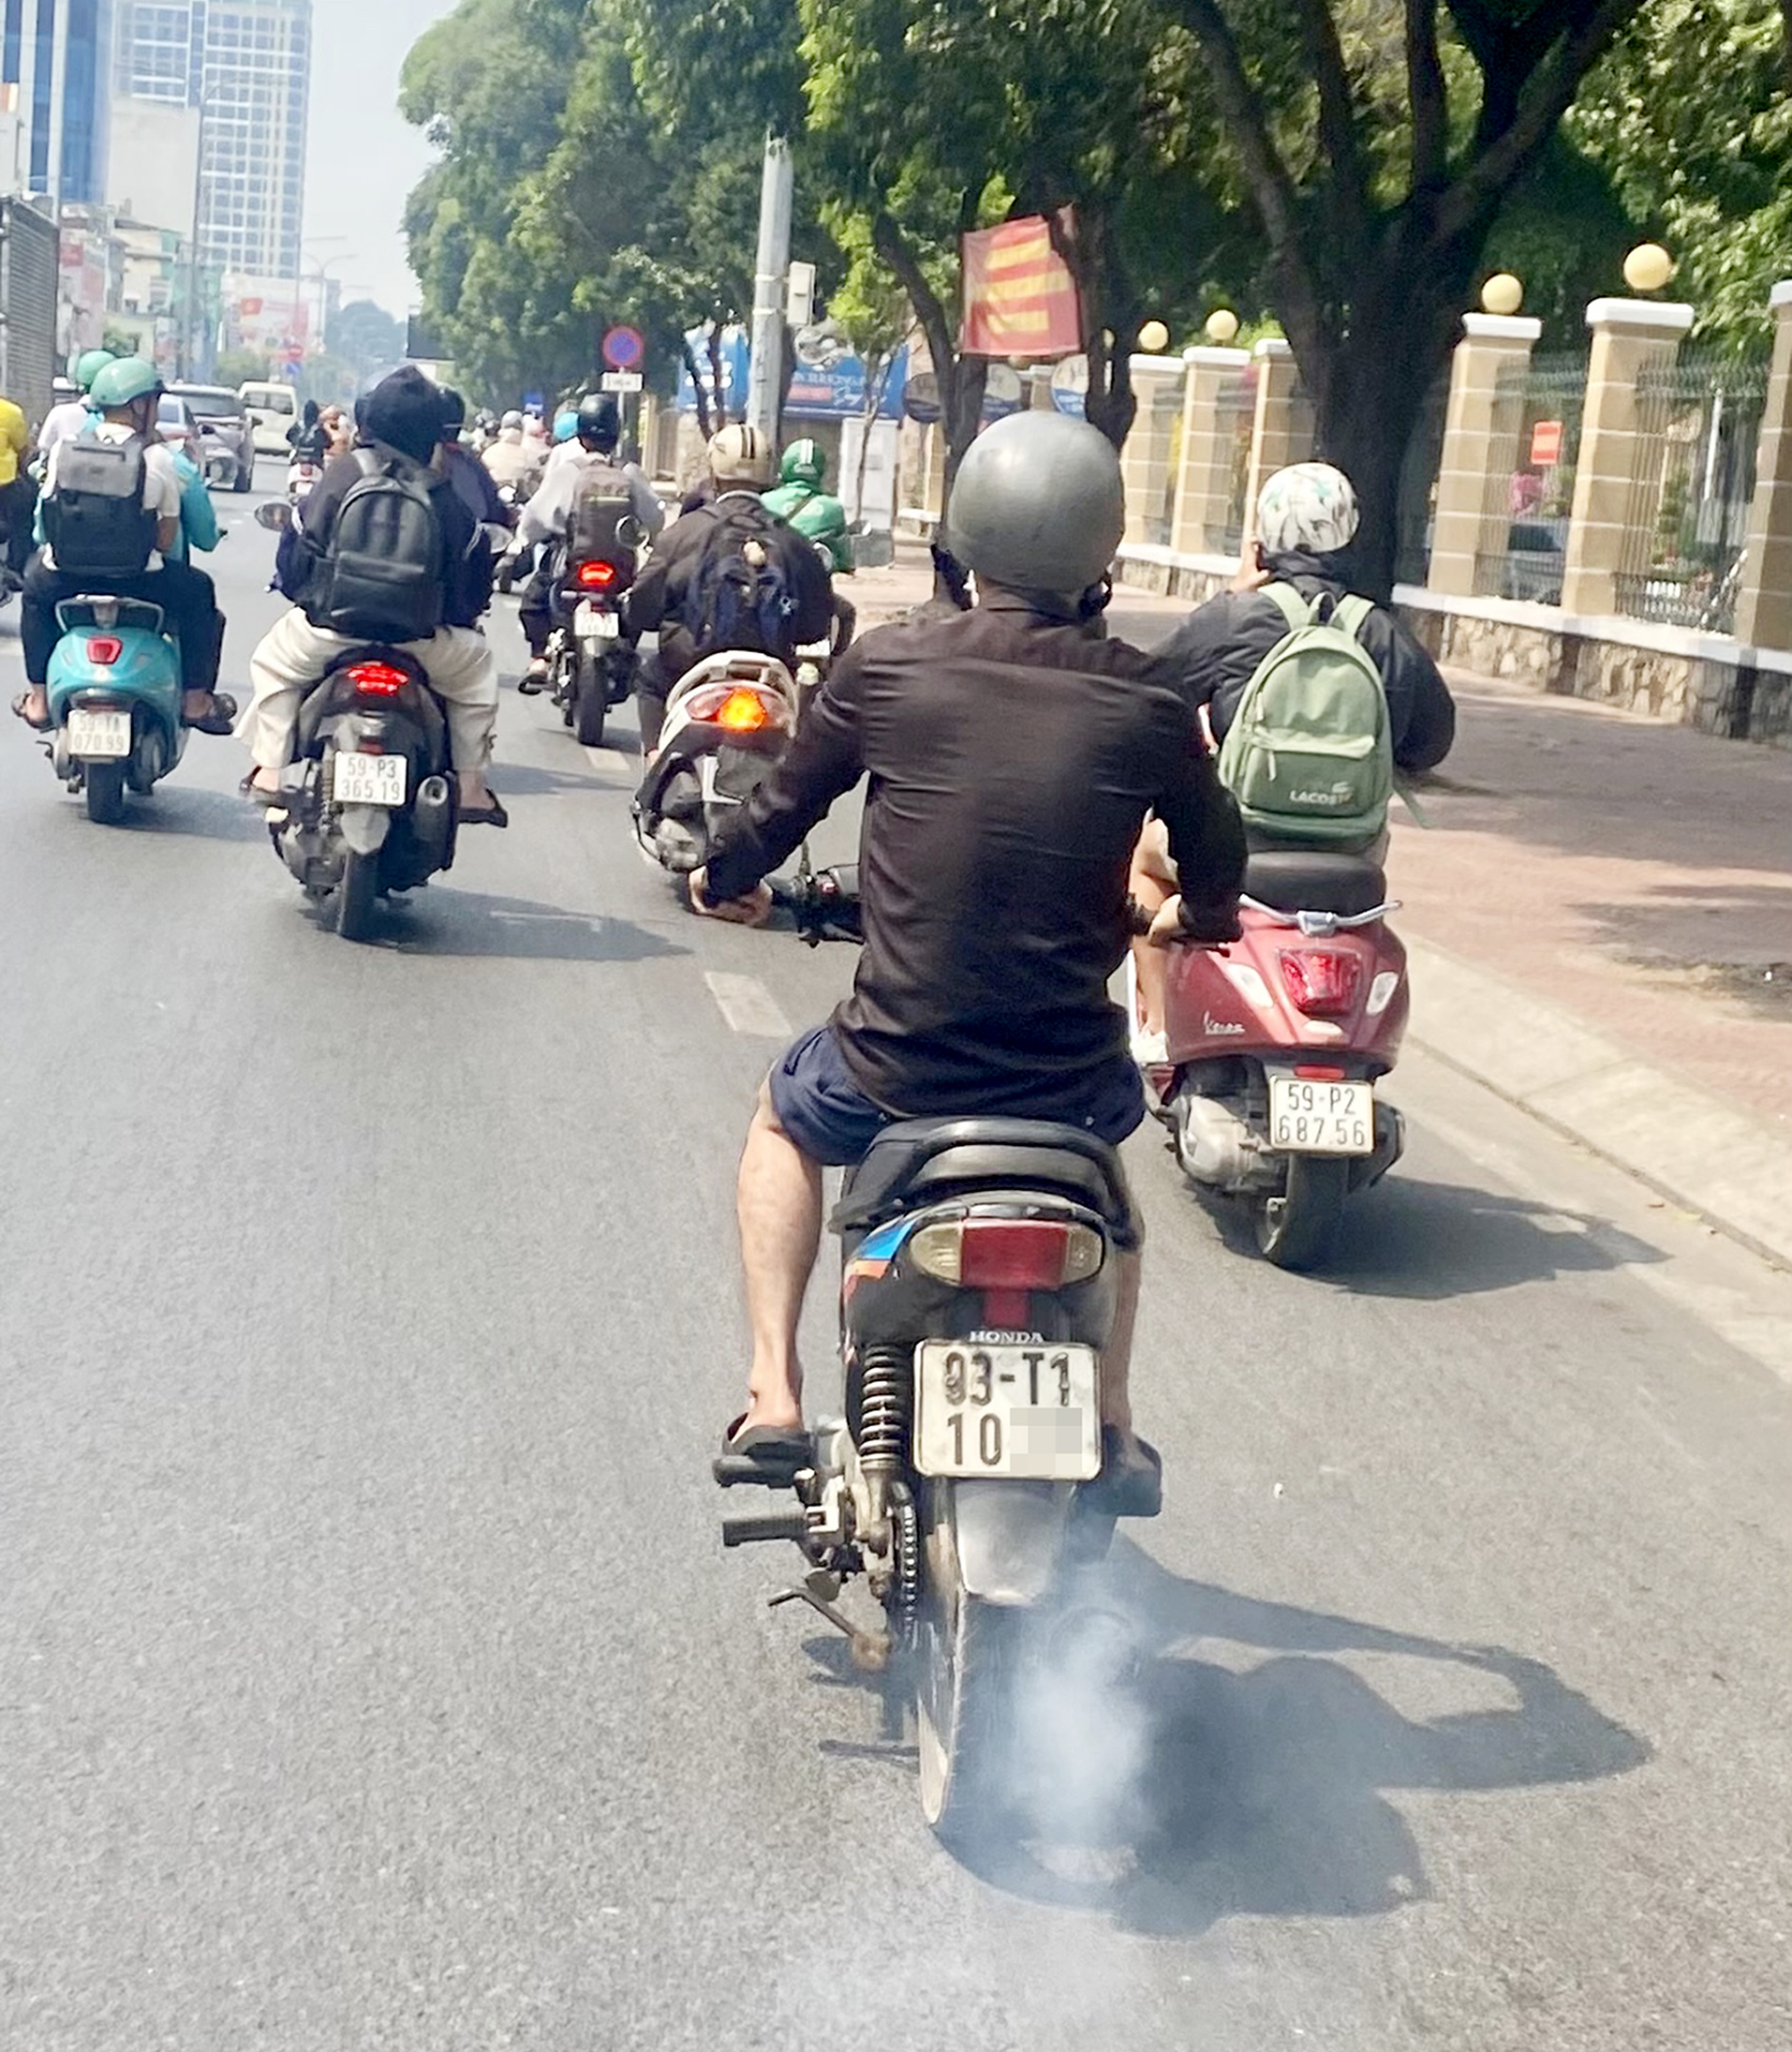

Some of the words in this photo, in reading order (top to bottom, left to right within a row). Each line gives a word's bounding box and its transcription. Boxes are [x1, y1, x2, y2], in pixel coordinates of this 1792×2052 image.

[347, 756, 397, 779] 59-P3
[341, 778, 401, 801] 365.19
[1287, 1083, 1356, 1116] 59-P2
[969, 1331, 1044, 1344] HONDA
[943, 1351, 1070, 1406] 93-T1
